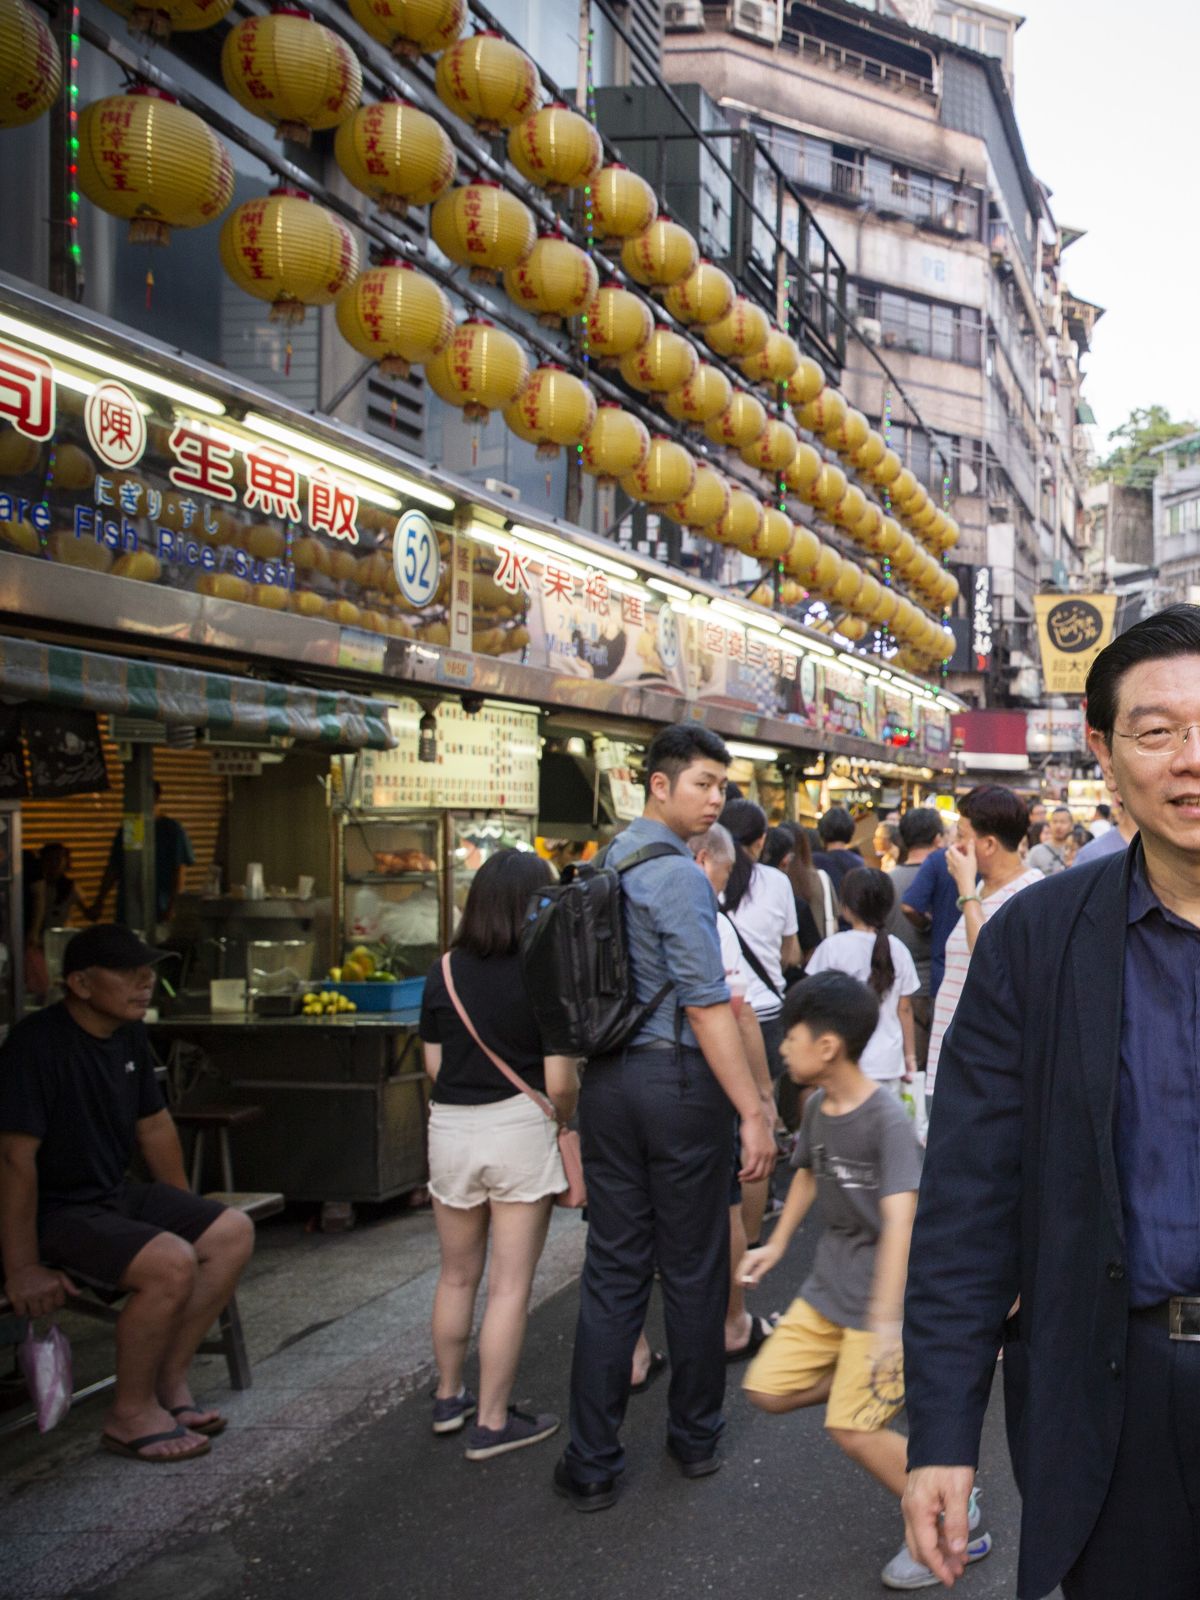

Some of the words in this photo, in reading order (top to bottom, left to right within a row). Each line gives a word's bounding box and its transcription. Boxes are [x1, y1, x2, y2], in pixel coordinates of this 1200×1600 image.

[100, 399, 134, 452] 陳
[171, 424, 359, 543] 生魚飯
[74, 504, 139, 552] Fish
[404, 529, 431, 590] 52
